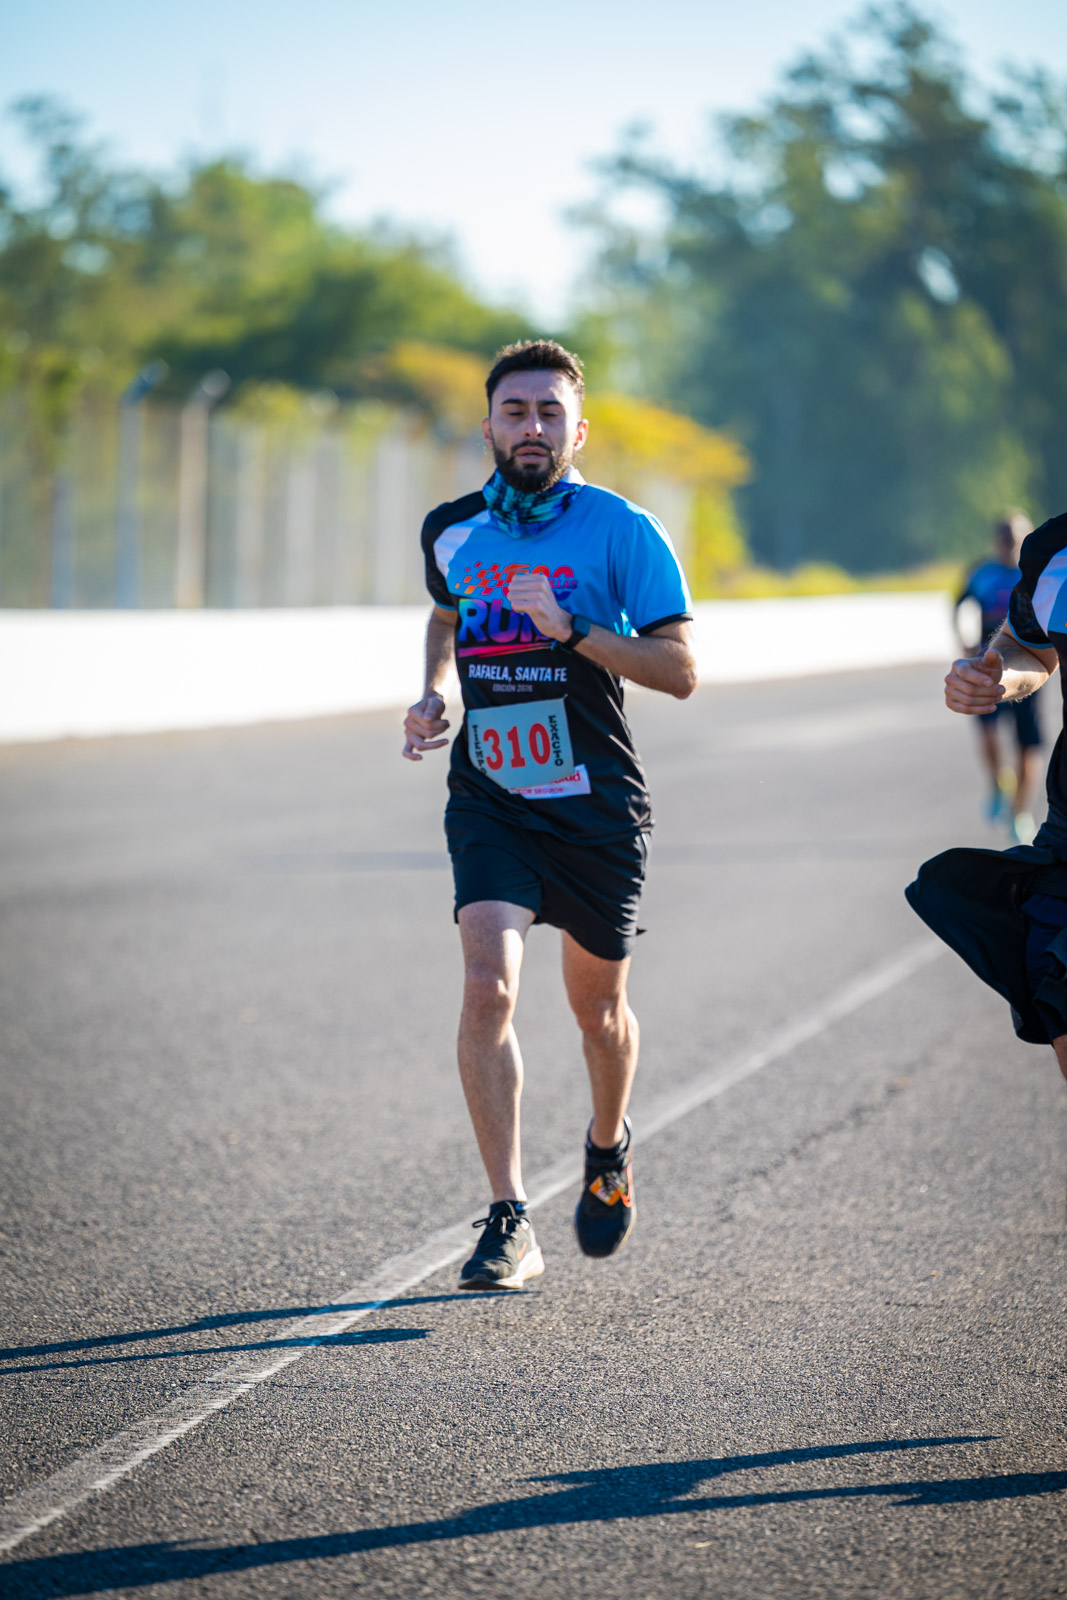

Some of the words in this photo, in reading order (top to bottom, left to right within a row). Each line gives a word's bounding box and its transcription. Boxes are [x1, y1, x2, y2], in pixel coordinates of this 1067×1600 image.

[468, 664, 512, 682] RAFAELA,
[515, 666, 552, 681] SANTA
[554, 667, 568, 682] FE
[483, 722, 551, 771] 310
[548, 715, 564, 767] EXACTO
